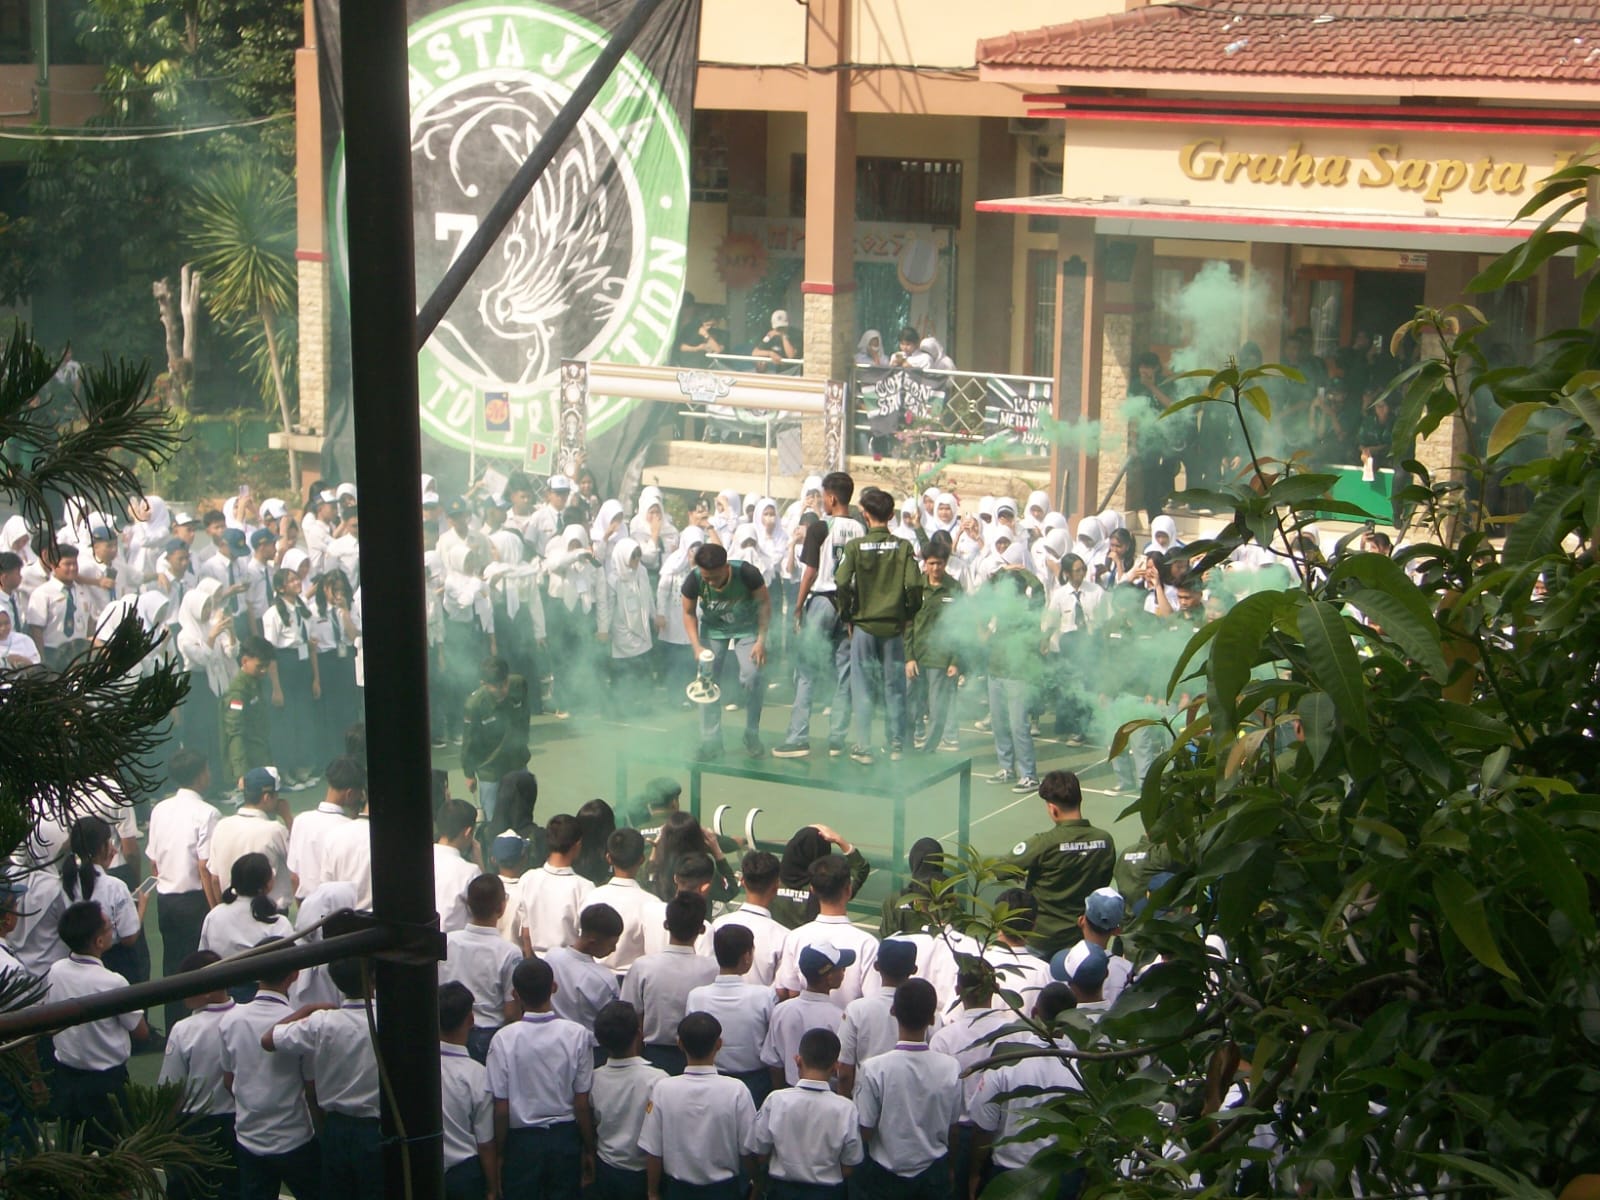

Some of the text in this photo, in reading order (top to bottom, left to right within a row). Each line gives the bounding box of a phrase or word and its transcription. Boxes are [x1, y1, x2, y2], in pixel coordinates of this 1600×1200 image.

[1178, 136, 1351, 186] Graha
[1360, 143, 1526, 203] Sapta
[427, 368, 472, 428] TO
[532, 443, 546, 461] P
